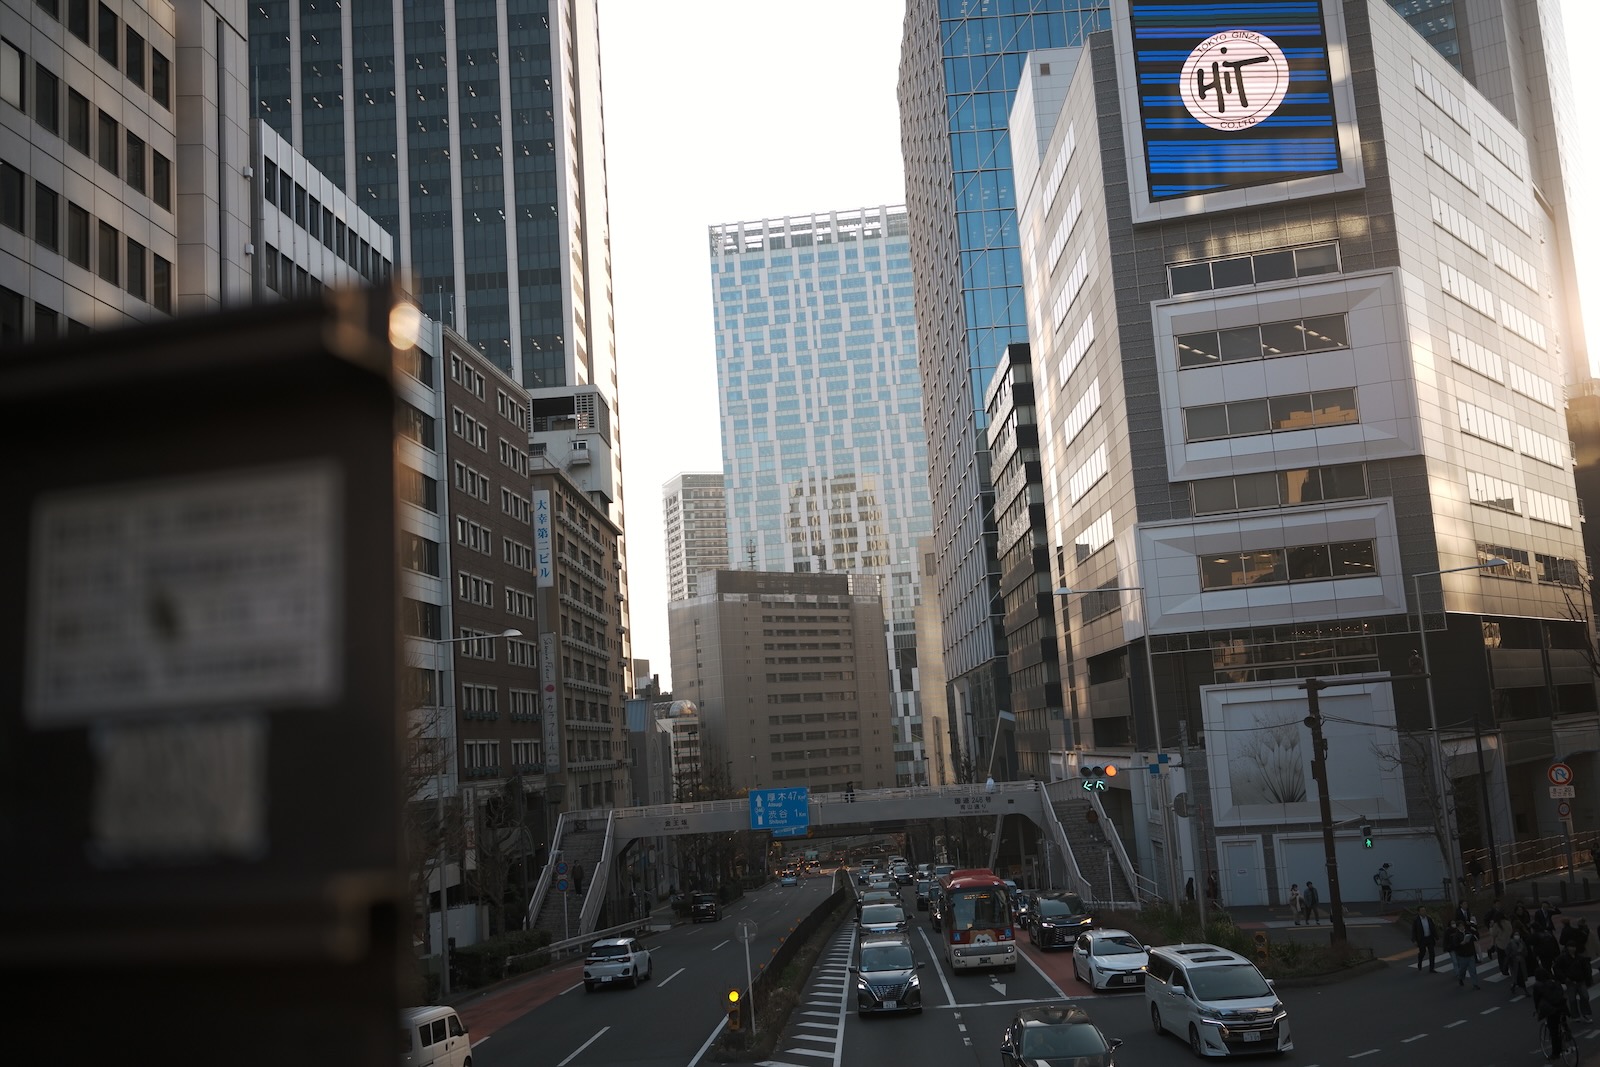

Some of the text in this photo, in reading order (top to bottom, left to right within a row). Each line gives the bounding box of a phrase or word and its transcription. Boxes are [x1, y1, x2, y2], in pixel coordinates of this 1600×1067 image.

[1197, 31, 1261, 53] TOKYO GINZA
[536, 499, 551, 578] 大幸第二ビル
[768, 809, 788, 819] 渋谷
